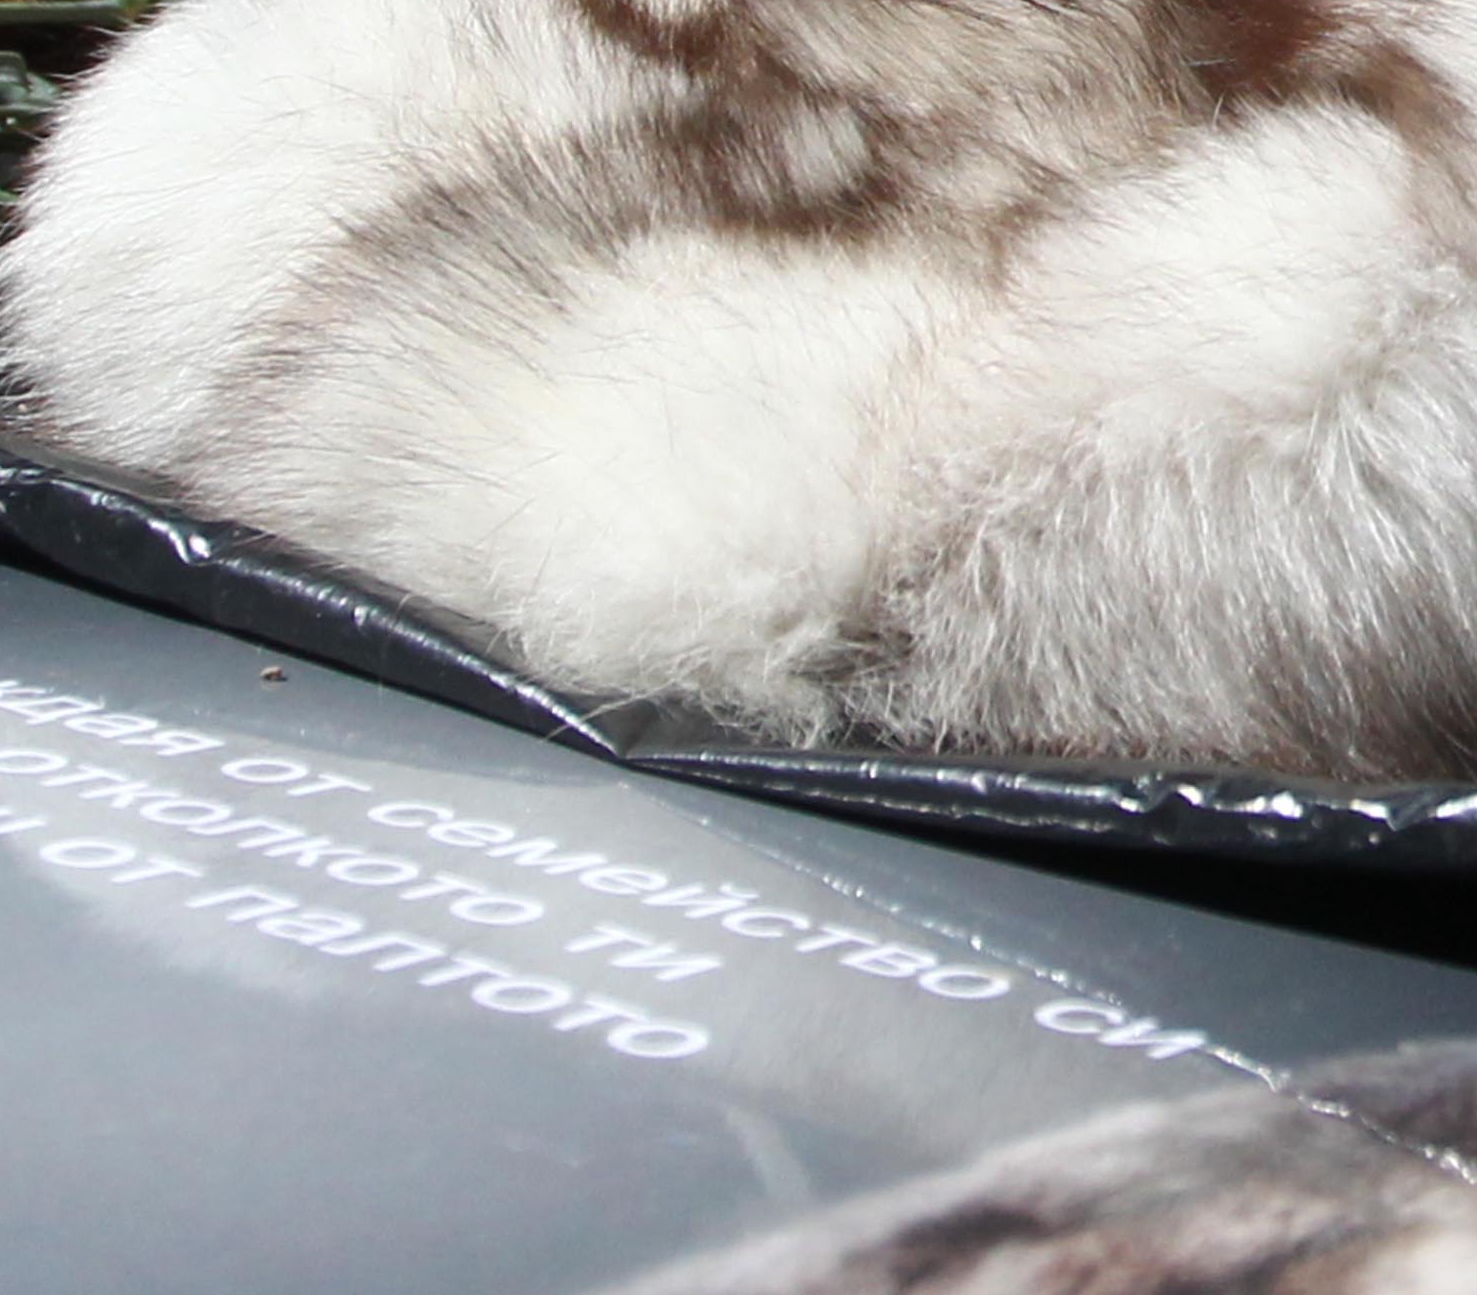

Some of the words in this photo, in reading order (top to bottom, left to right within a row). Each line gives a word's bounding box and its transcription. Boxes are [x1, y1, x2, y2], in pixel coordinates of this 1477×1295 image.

[36, 837, 209, 886] от
[186, 885, 709, 1061] палтото
[222, 754, 372, 795] от
[365, 798, 1009, 1001] семейство
[1032, 997, 1208, 1061] си
[564, 922, 723, 984] ти
